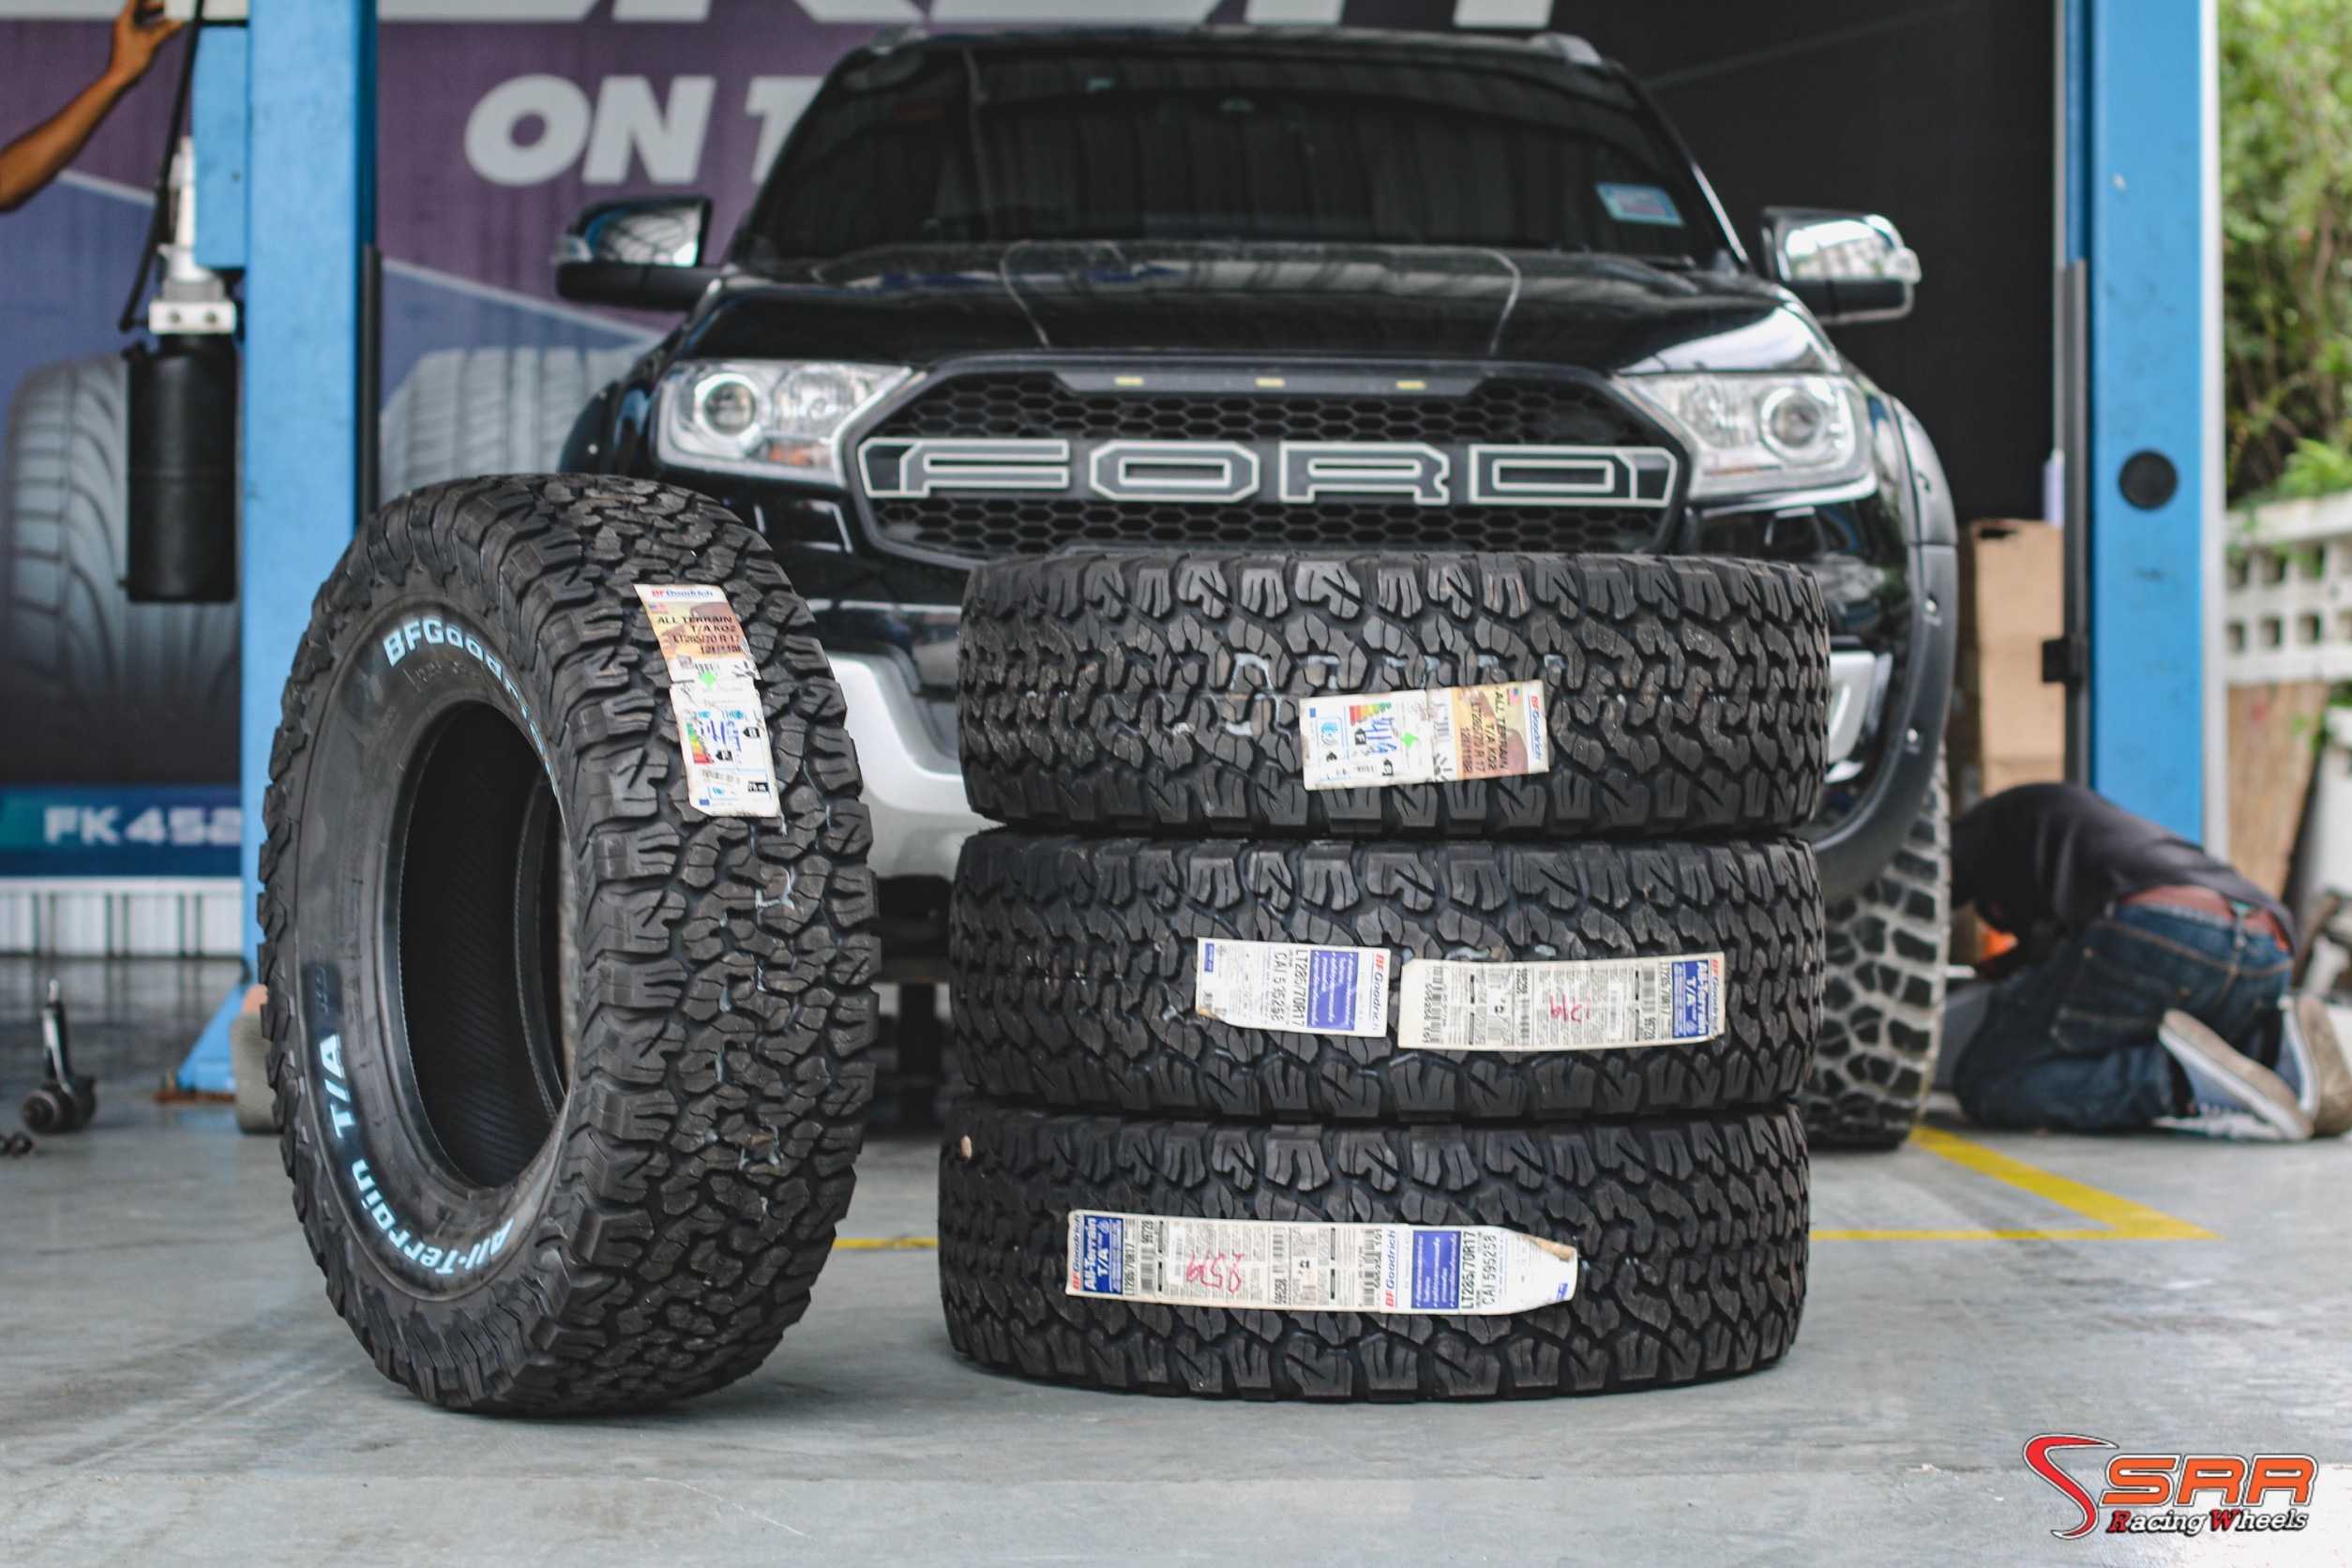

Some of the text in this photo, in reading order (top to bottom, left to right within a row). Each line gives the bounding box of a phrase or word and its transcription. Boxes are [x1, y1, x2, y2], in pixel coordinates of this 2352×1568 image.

[462, 74, 716, 186] ON
[856, 436, 1677, 508] FORD
[1686, 976, 1697, 1007] T/A
[1696, 961, 1709, 1035] All-Terrain
[320, 1033, 355, 1138] T/A
[1084, 1217, 1096, 1290] All-Terrain
[1097, 1247, 1109, 1277] T/A
[1385, 1229, 1395, 1307] BFGoodrich
